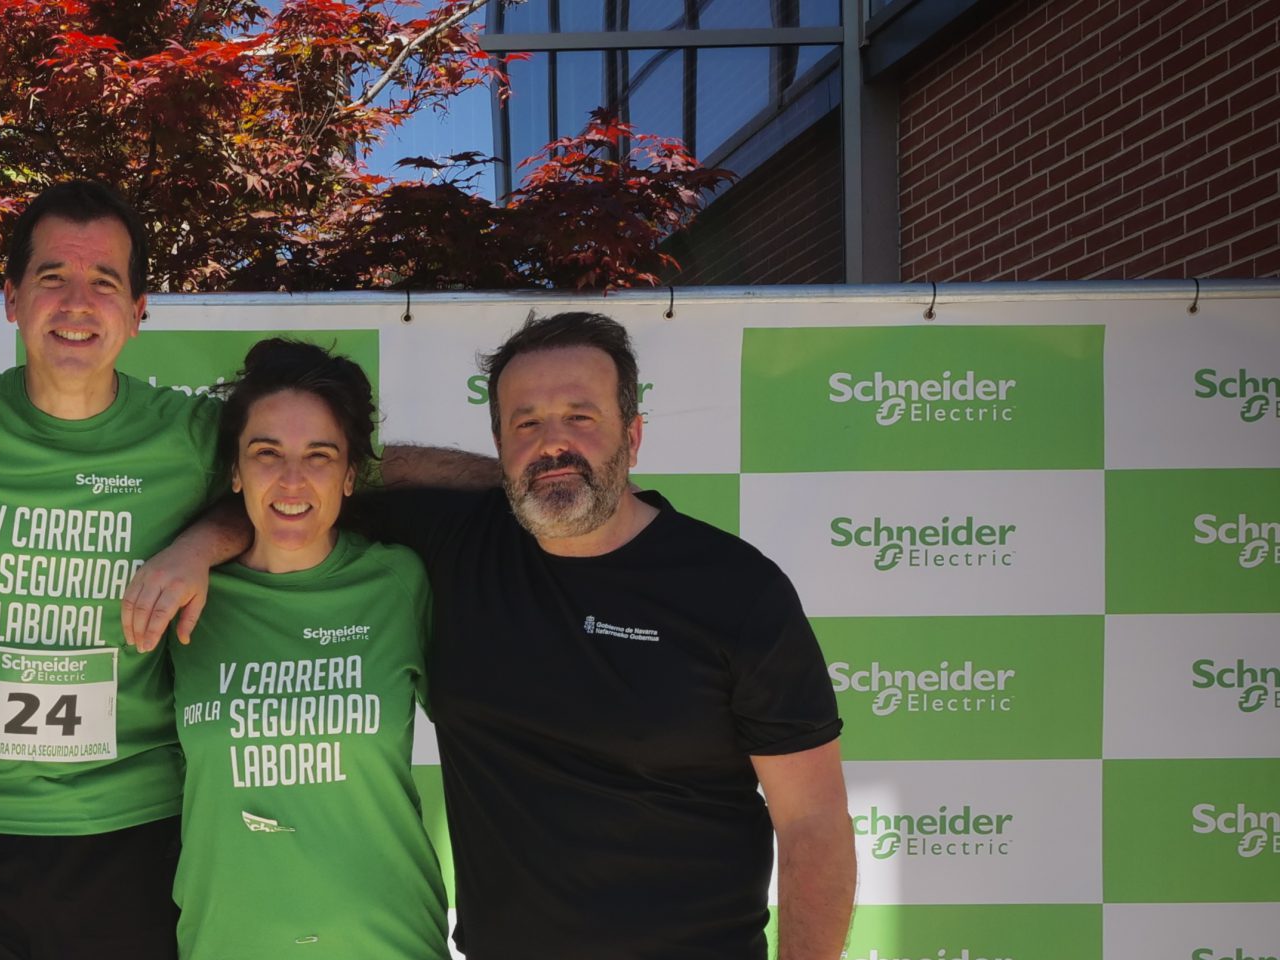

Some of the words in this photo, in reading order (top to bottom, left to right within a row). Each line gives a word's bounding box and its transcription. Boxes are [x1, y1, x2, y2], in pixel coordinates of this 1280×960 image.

[829, 371, 1016, 402] Schneider
[910, 403, 1013, 422] Electric
[75, 473, 143, 487] Schneider
[104, 485, 142, 494] Electric
[12, 507, 132, 553] CARRERA
[830, 517, 1016, 547] Schneider
[909, 550, 1013, 567] Electric
[303, 625, 370, 639] Schneider
[332, 634, 369, 643] Electric
[1, 654, 87, 672] Schneider
[38, 672, 86, 681] Electric
[220, 662, 237, 694] V
[241, 655, 362, 695] CARRERA
[828, 661, 1015, 692] Schneider
[908, 694, 1012, 712] Electric
[4, 692, 82, 736] 24
[184, 702, 202, 727] POR
[205, 701, 221, 721] LA
[229, 694, 380, 739] SEGURIDAD
[12, 743, 26, 756] POR
[28, 744, 37, 756] LA
[38, 744, 79, 757] SEGURIDAD
[81, 742, 111, 756] LABORAL
[230, 742, 347, 788] LABORAL
[852, 805, 1013, 835] chneider
[907, 838, 1009, 856] Electric
